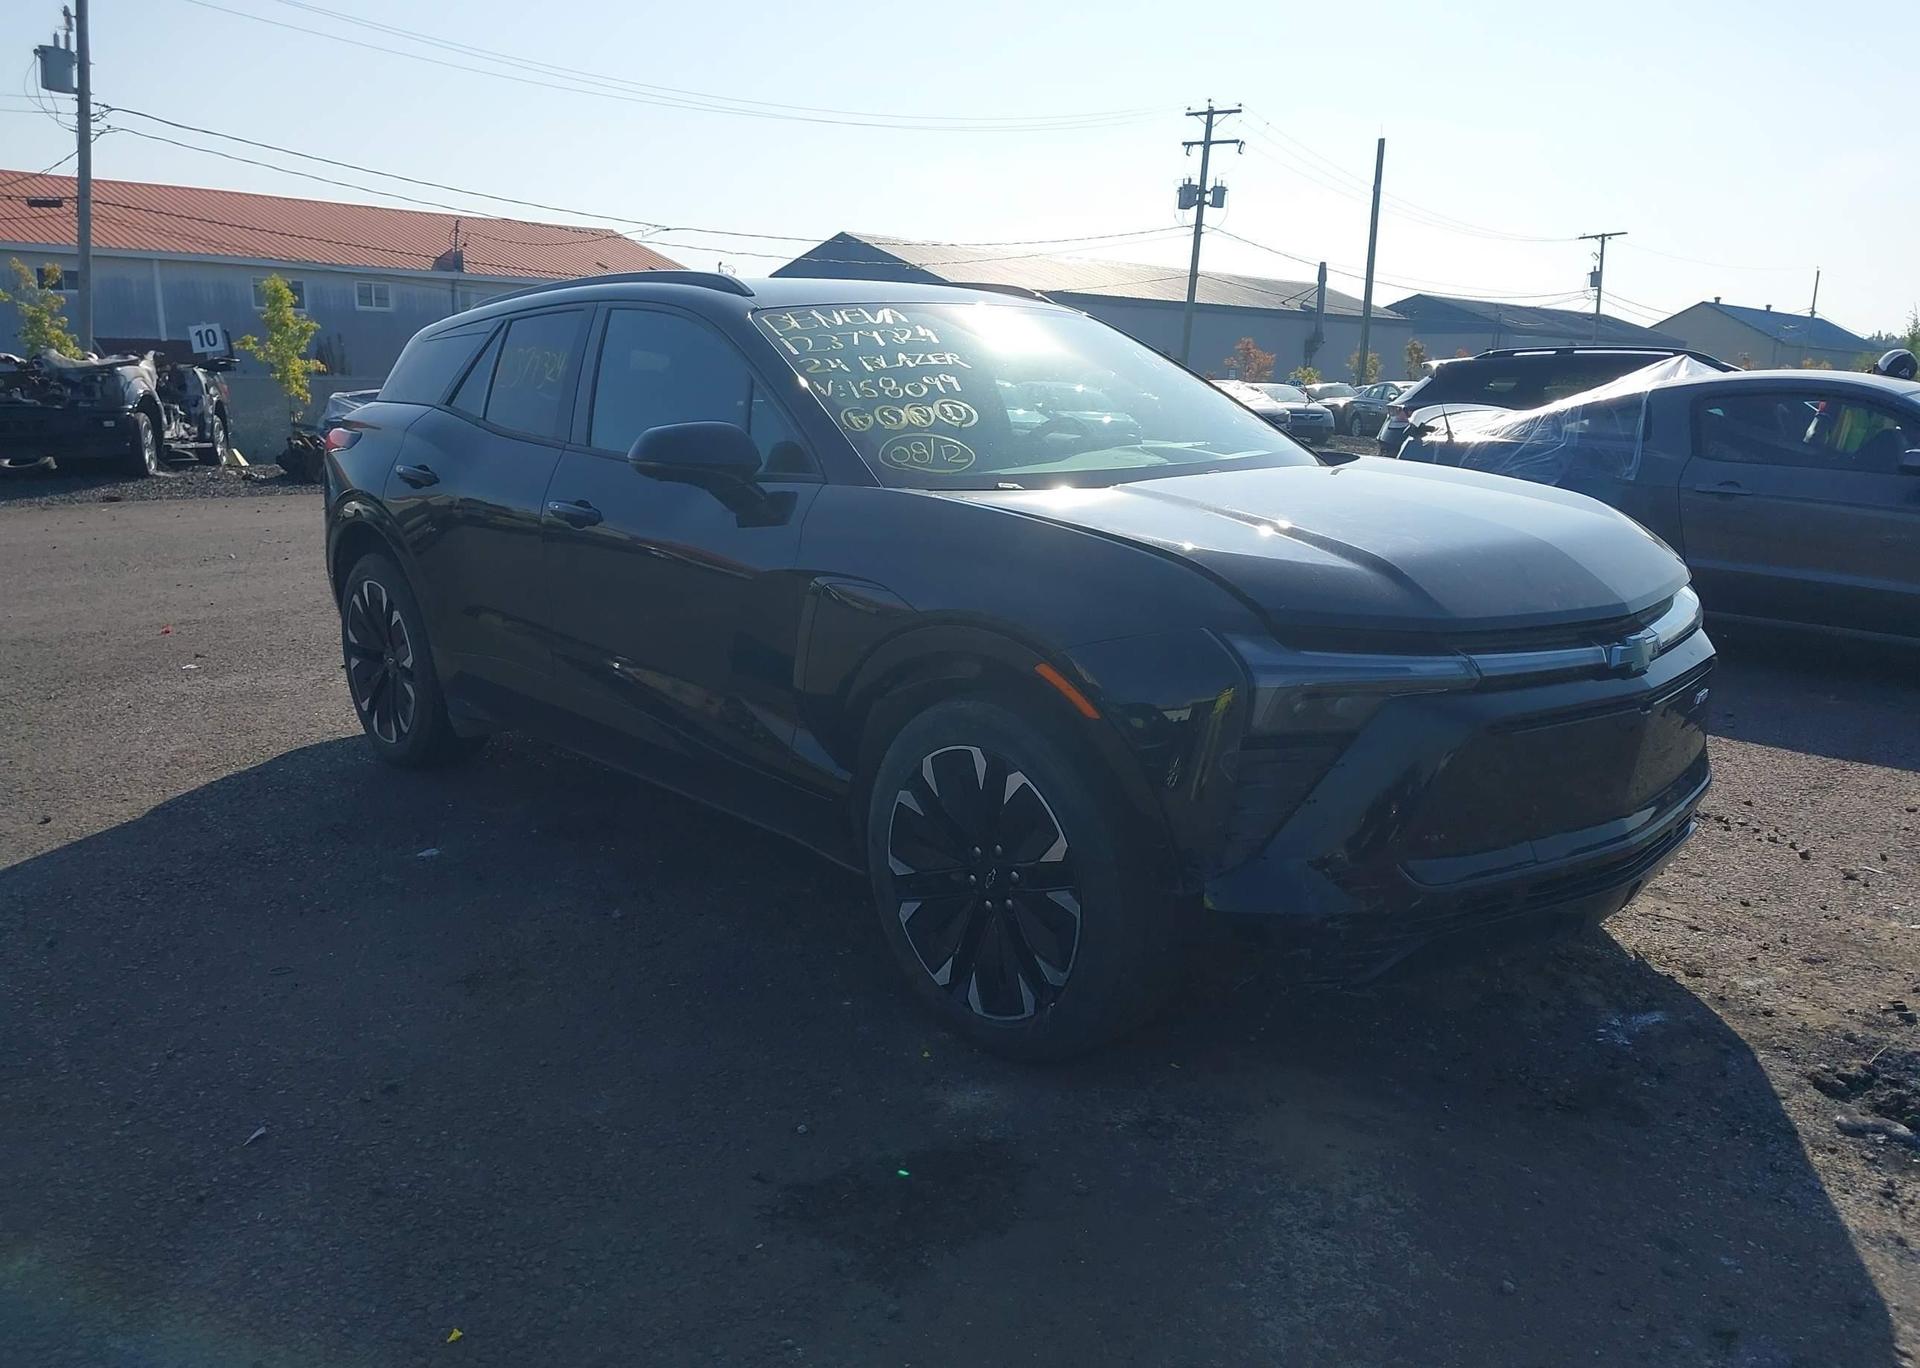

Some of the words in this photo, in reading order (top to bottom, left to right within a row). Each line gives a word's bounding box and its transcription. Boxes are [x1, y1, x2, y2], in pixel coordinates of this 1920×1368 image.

[760, 307, 909, 337] BENEVA
[195, 328, 218, 348] 10
[798, 357, 852, 374] 24
[857, 351, 973, 372] BLAZER
[889, 437, 970, 465] 08/12
